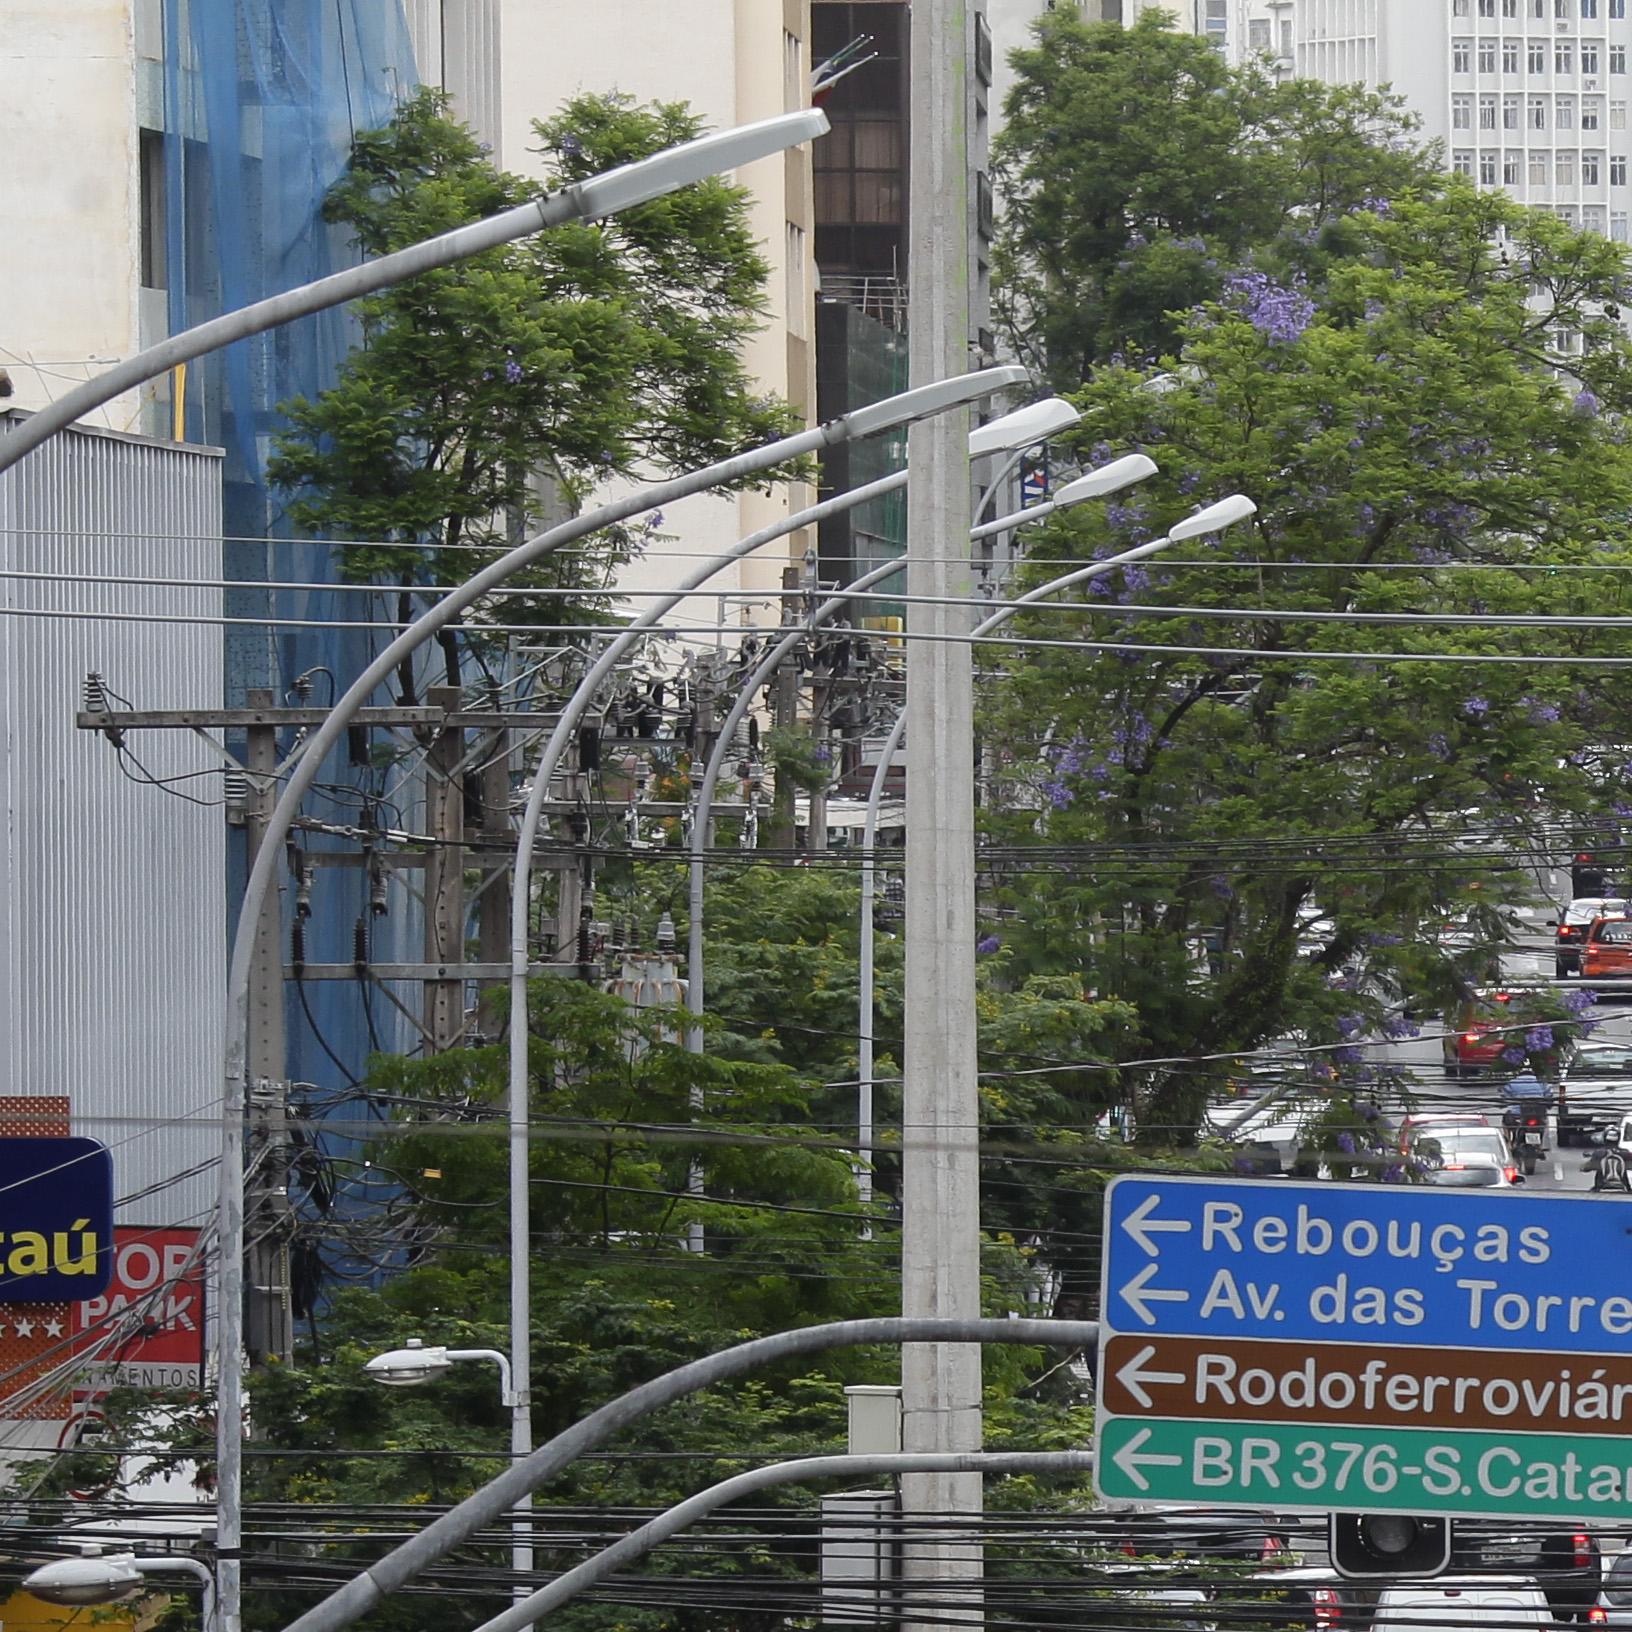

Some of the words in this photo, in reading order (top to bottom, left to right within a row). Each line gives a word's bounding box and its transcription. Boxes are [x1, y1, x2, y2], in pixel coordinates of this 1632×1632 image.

[0, 1217, 98, 1277] aú
[1201, 1200, 1552, 1273] Rebouças
[79, 1291, 198, 1335] PARK
[1200, 1269, 1285, 1322] Av.
[1309, 1274, 1425, 1326] das
[1192, 1436, 1281, 1487] BR
